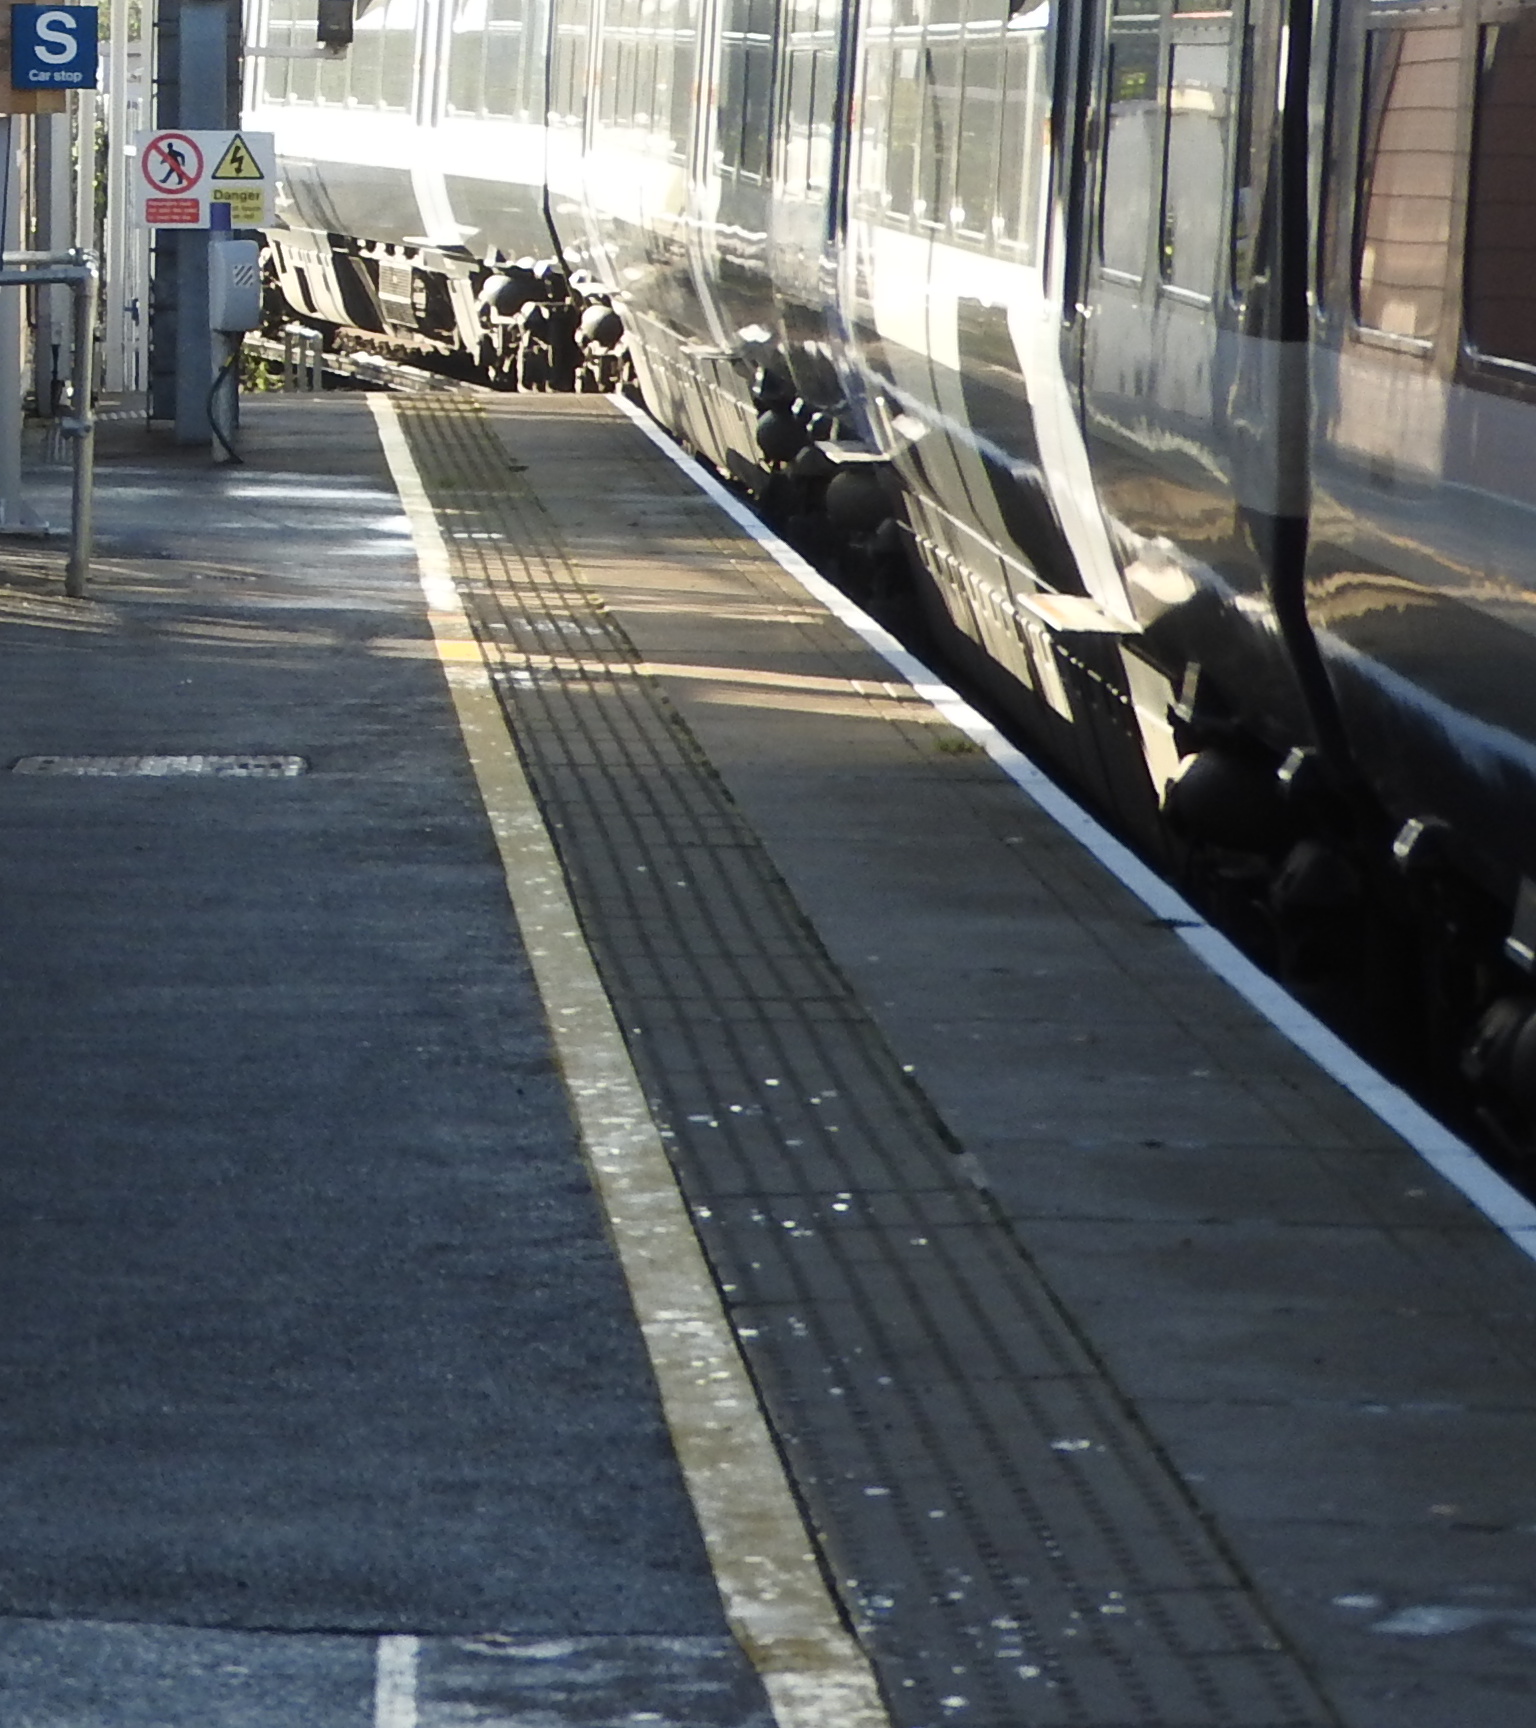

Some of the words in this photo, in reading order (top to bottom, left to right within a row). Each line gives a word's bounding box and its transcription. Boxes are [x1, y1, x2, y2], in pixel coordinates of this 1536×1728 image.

[33, 10, 77, 65] S
[28, 68, 51, 83] Car
[53, 69, 84, 86] stop
[213, 188, 260, 204] Danger
